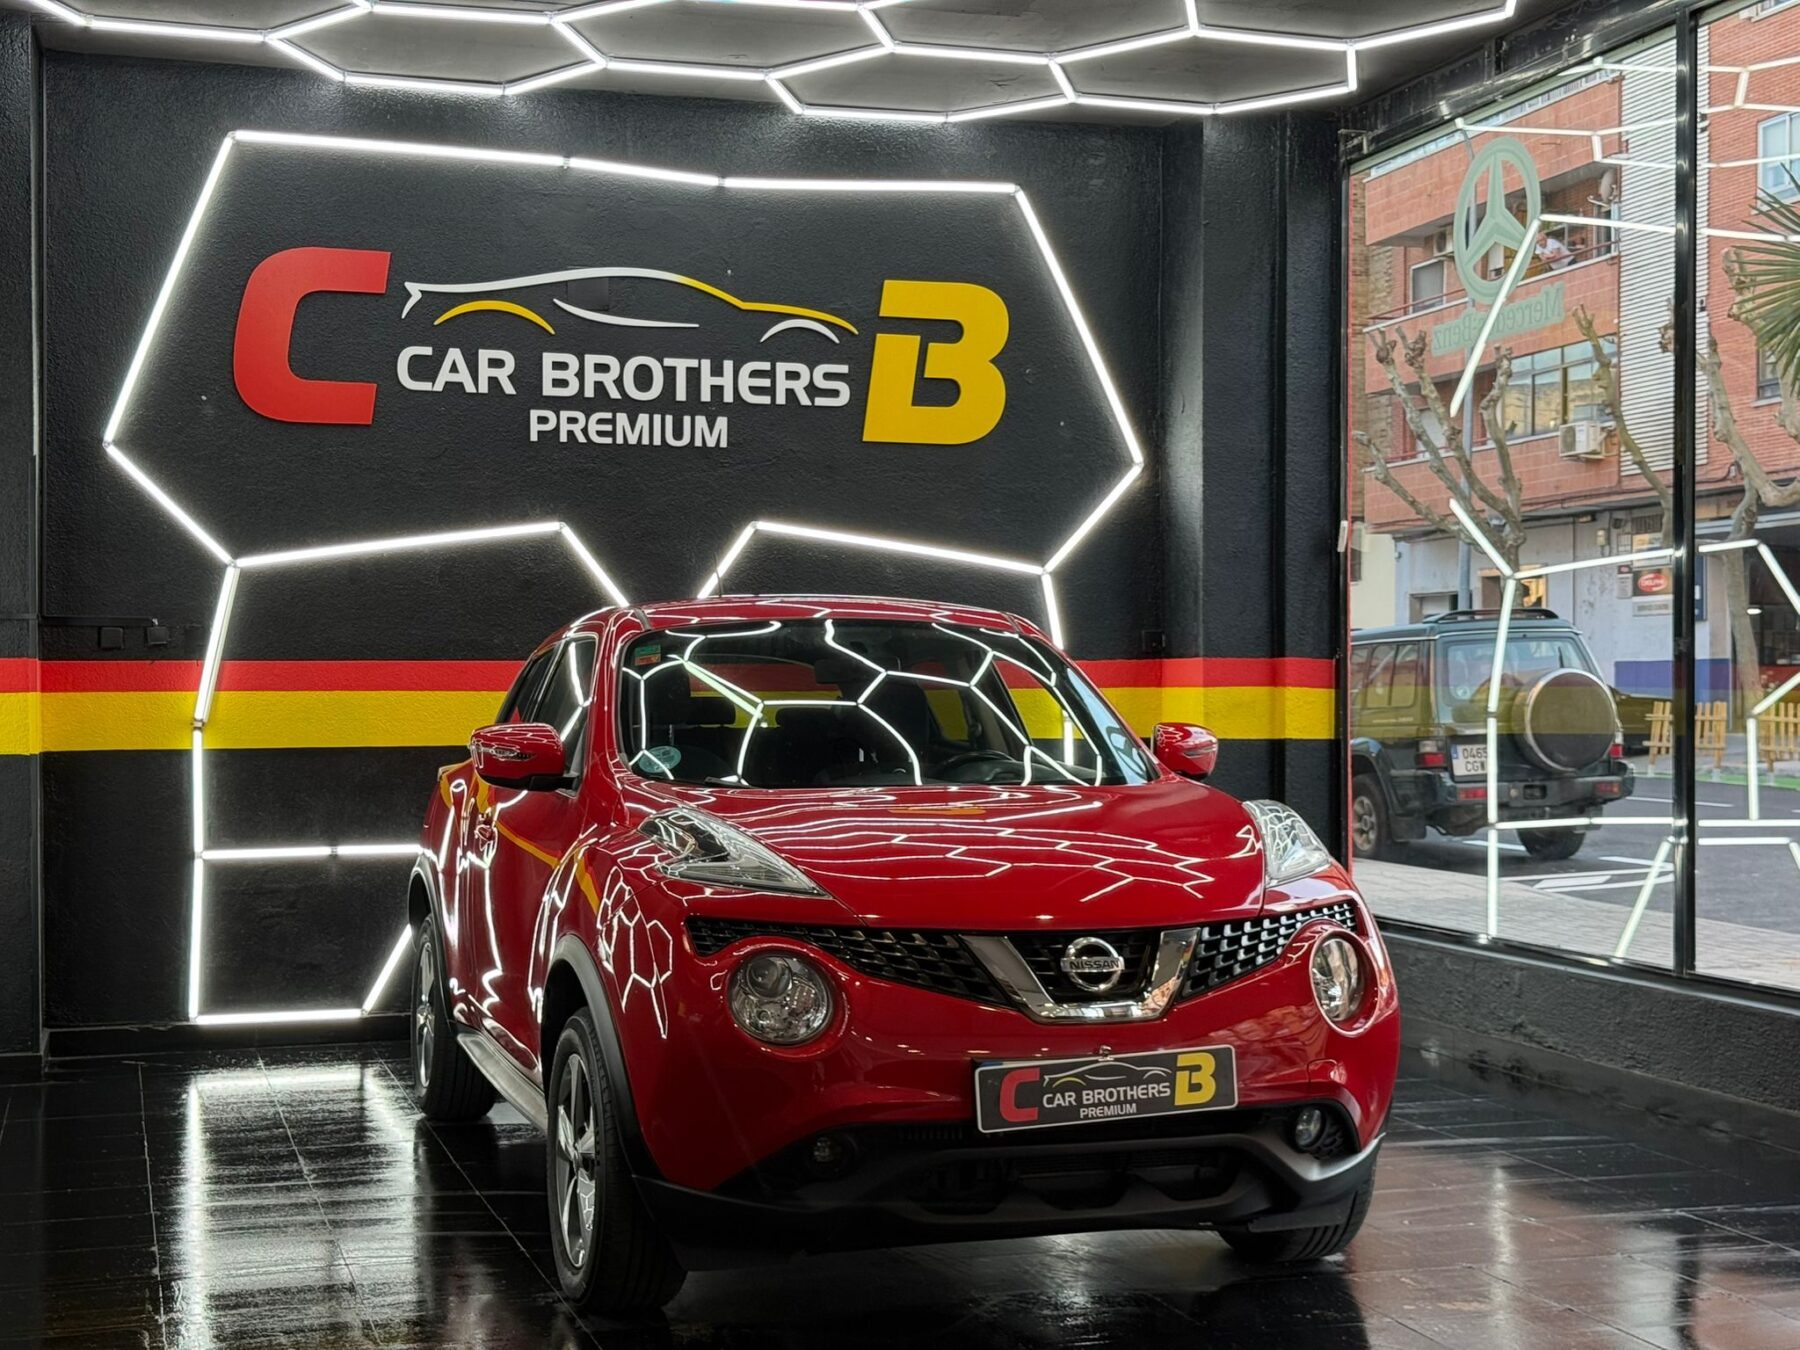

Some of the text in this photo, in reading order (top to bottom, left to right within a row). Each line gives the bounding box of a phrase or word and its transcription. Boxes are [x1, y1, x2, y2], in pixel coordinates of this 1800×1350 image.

[233, 246, 392, 426] C
[862, 279, 1010, 446] B
[396, 345, 851, 408] CAR BROTHERS
[528, 408, 729, 449] PREMIUM
[1069, 959, 1120, 970] NISSAN
[1000, 1066, 1041, 1122] C
[1043, 1082, 1171, 1108] CAR BROTHERS
[1174, 1051, 1216, 1106] B
[1079, 1102, 1137, 1119] PREMIUM
